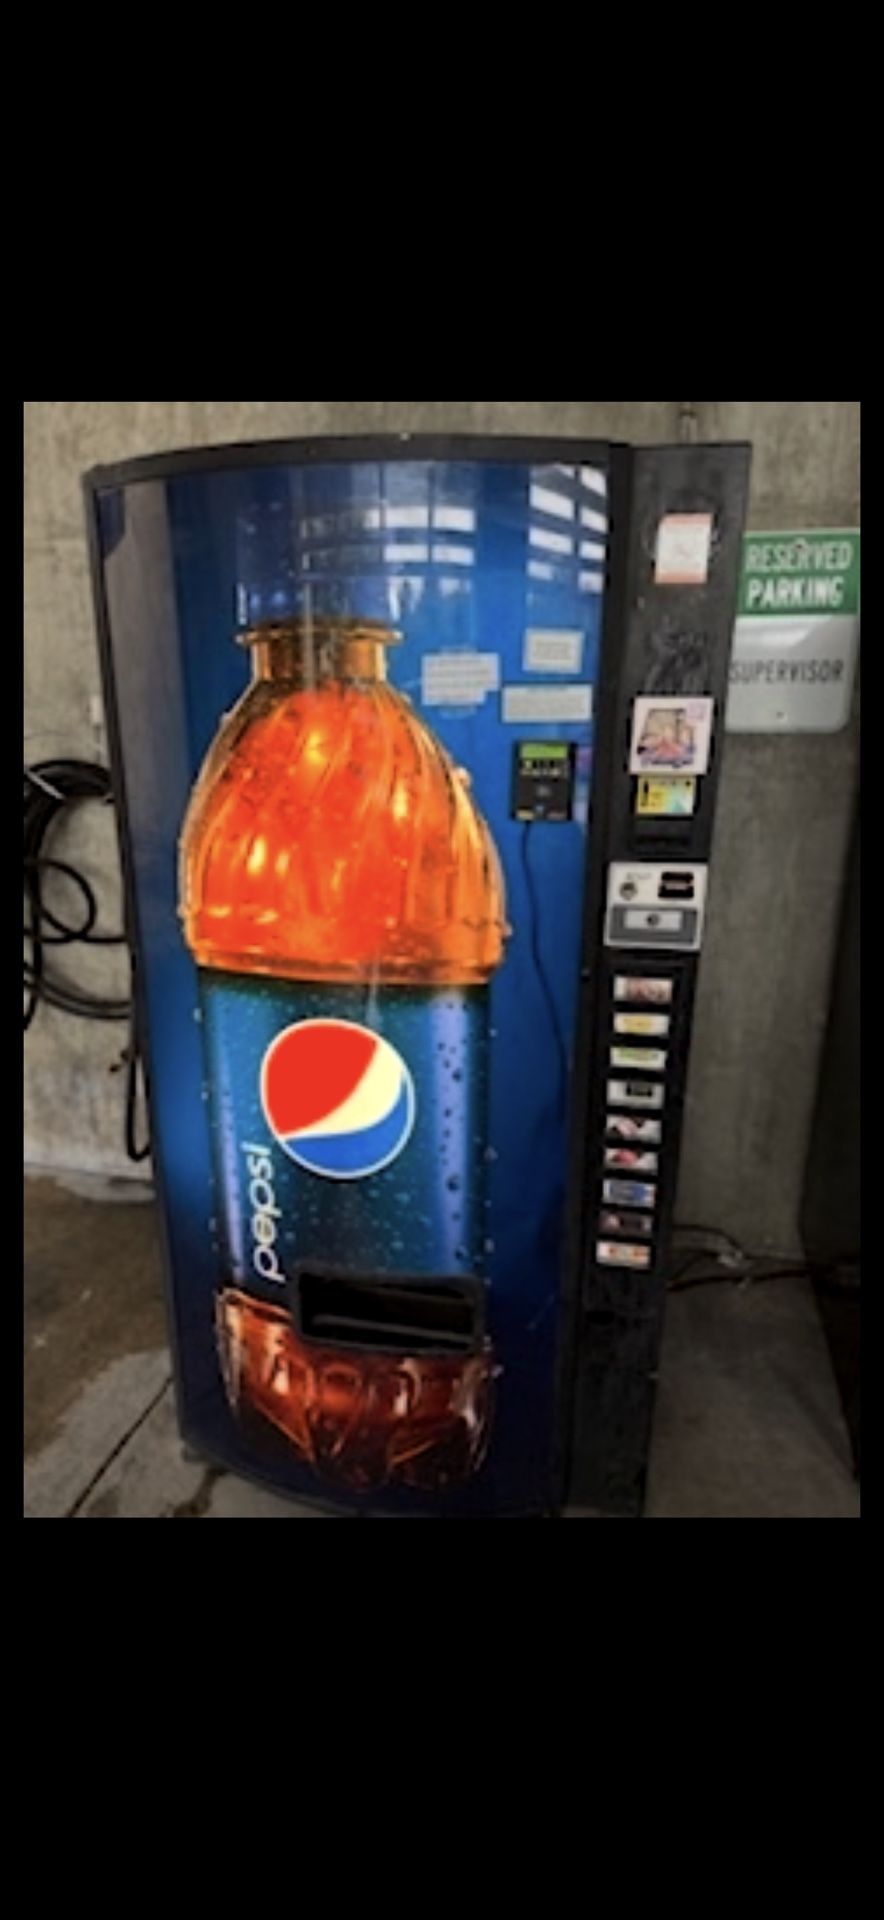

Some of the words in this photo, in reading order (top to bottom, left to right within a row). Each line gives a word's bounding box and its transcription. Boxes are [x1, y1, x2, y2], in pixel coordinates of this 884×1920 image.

[744, 541, 853, 572] RESERVED
[746, 576, 845, 608] PARKING
[728, 658, 844, 684] SUPERVISOR
[241, 1141, 286, 1282] pepsi
